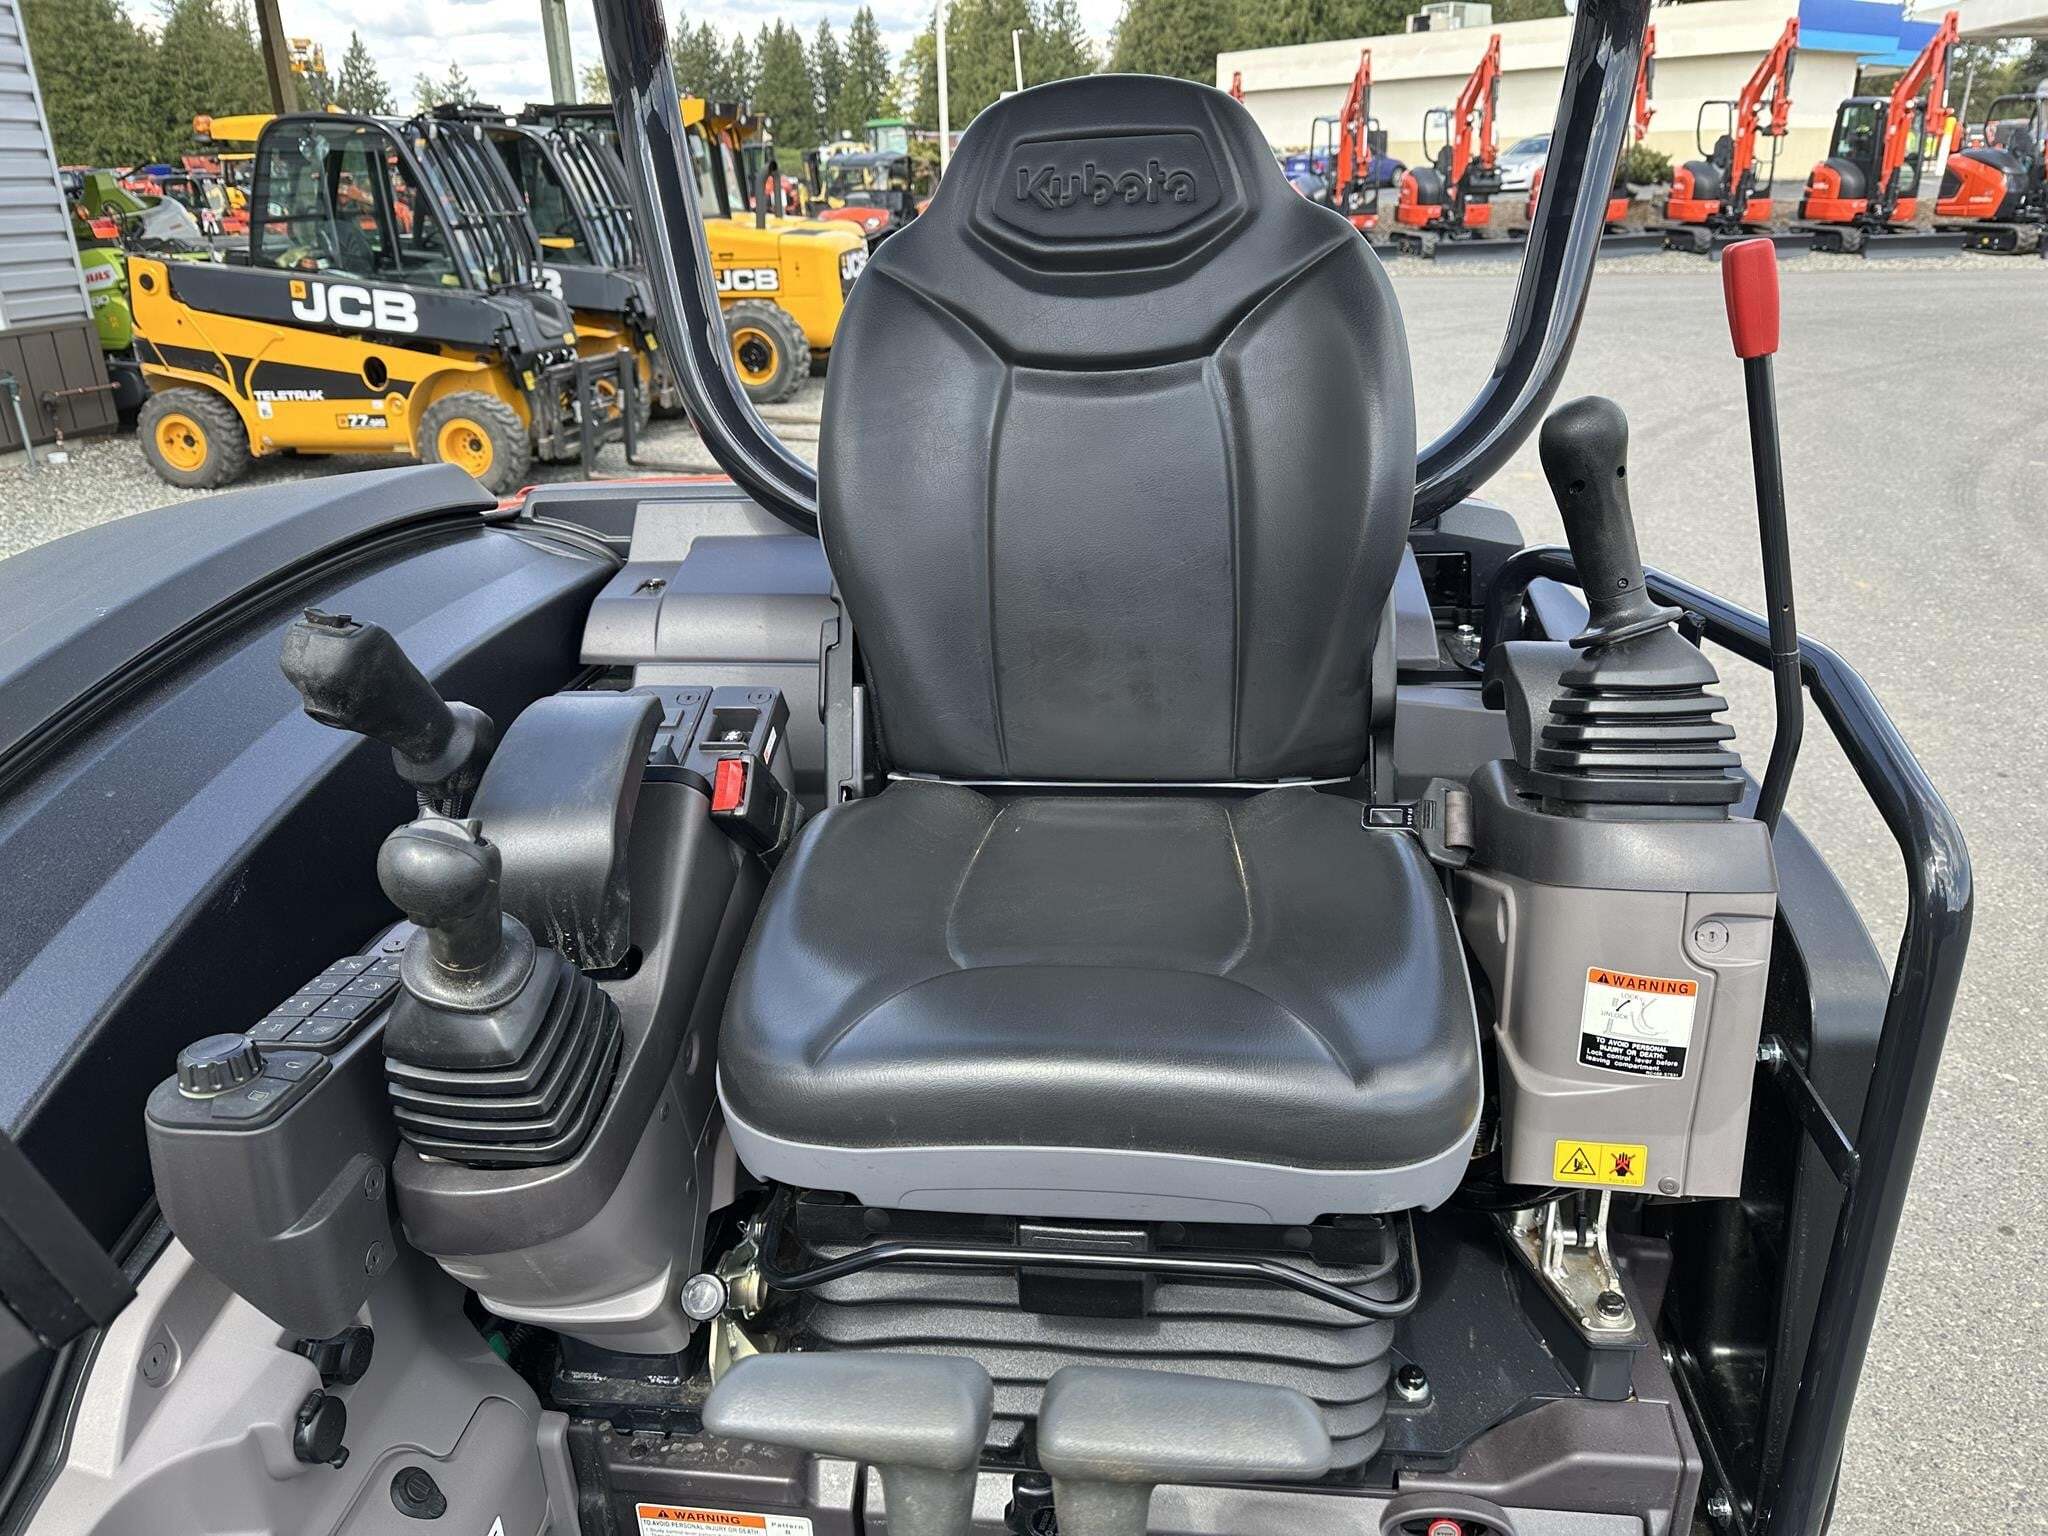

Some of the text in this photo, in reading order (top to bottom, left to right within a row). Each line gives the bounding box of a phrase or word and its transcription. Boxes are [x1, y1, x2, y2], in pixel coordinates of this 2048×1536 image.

[1017, 160, 1196, 209] Kubota
[716, 268, 779, 291] JCB
[291, 280, 419, 333] JCB
[1613, 975, 1689, 994] WARNING
[1596, 1036, 1668, 1053] TO AVOID PERSONAL
[1600, 1044, 1624, 1055] INJURY
[1626, 1049, 1637, 1057] OR
[1585, 1054, 1611, 1066] leaving
[1586, 1047, 1679, 1067] Lock control lever before
[673, 1511, 741, 1525] WARNING
